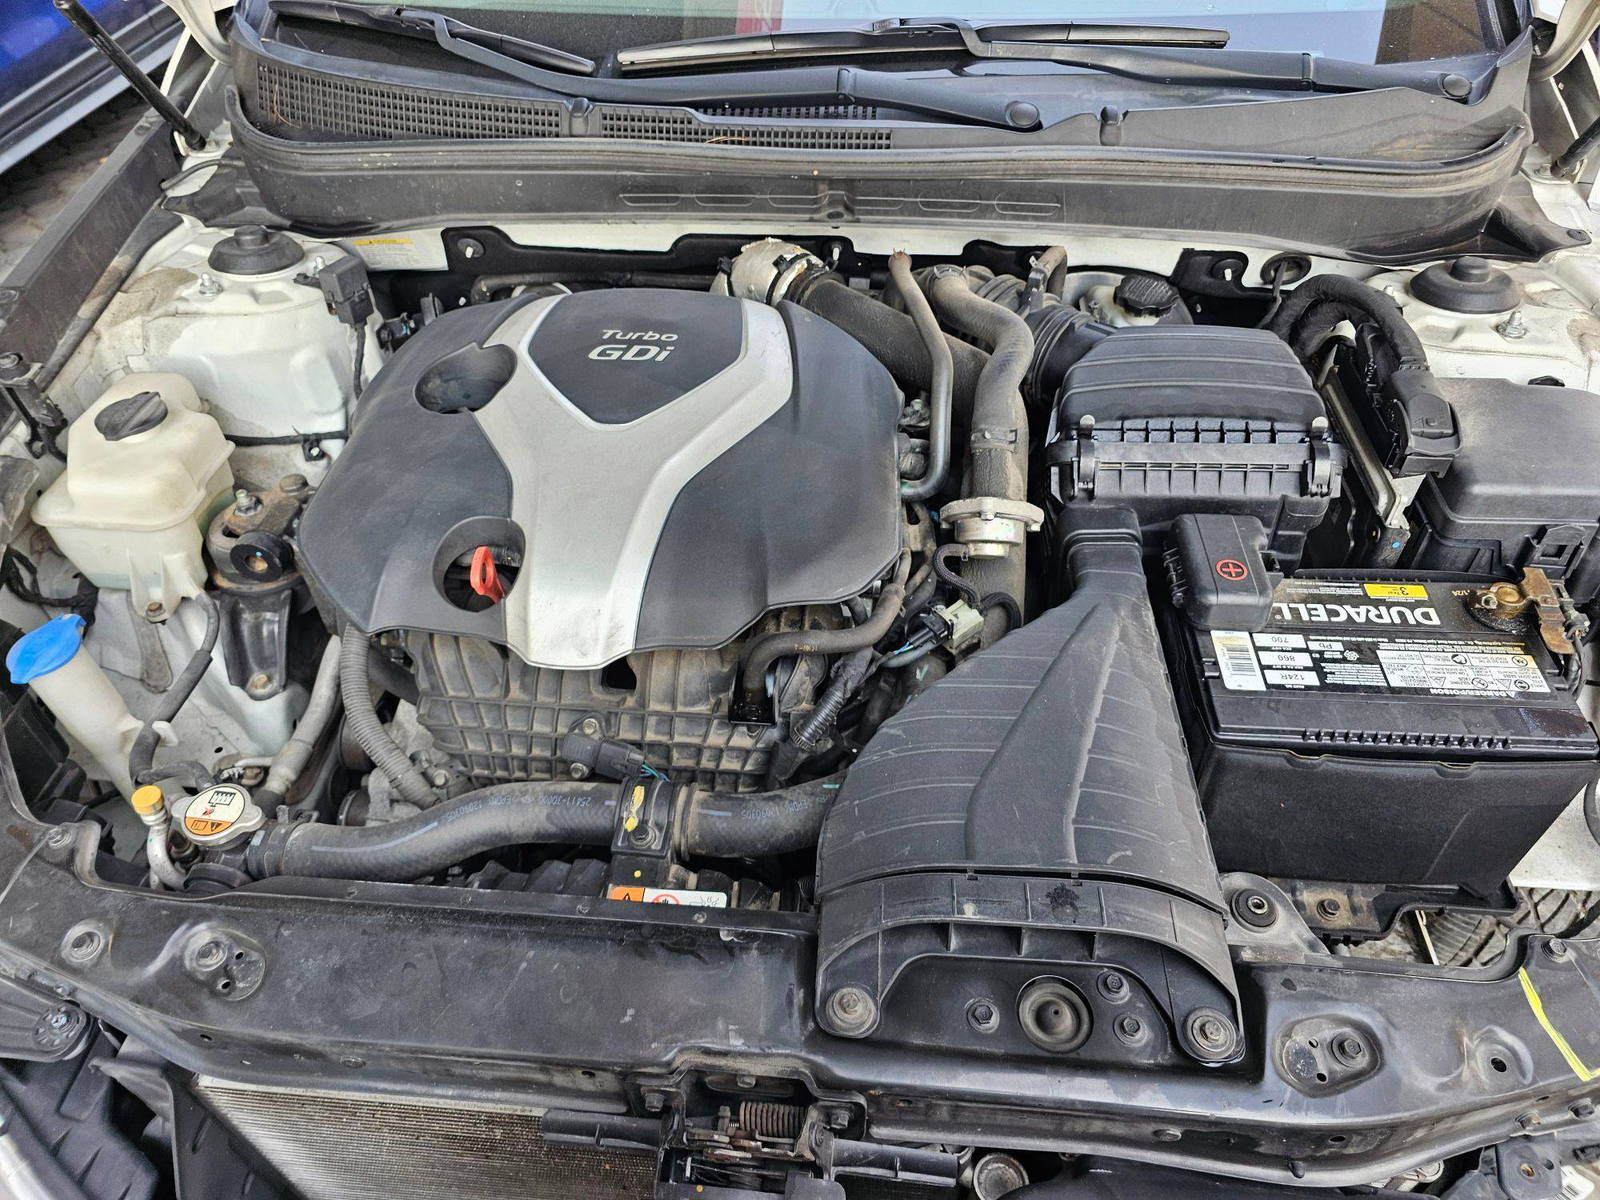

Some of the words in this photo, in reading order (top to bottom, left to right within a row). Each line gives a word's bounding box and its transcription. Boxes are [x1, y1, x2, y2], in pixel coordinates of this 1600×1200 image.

[602, 329, 679, 341] Turbo
[587, 344, 675, 361] GDi
[1400, 586, 1409, 596] 3
[1272, 602, 1441, 625] DURACELL
[1281, 673, 1305, 681] 124R
